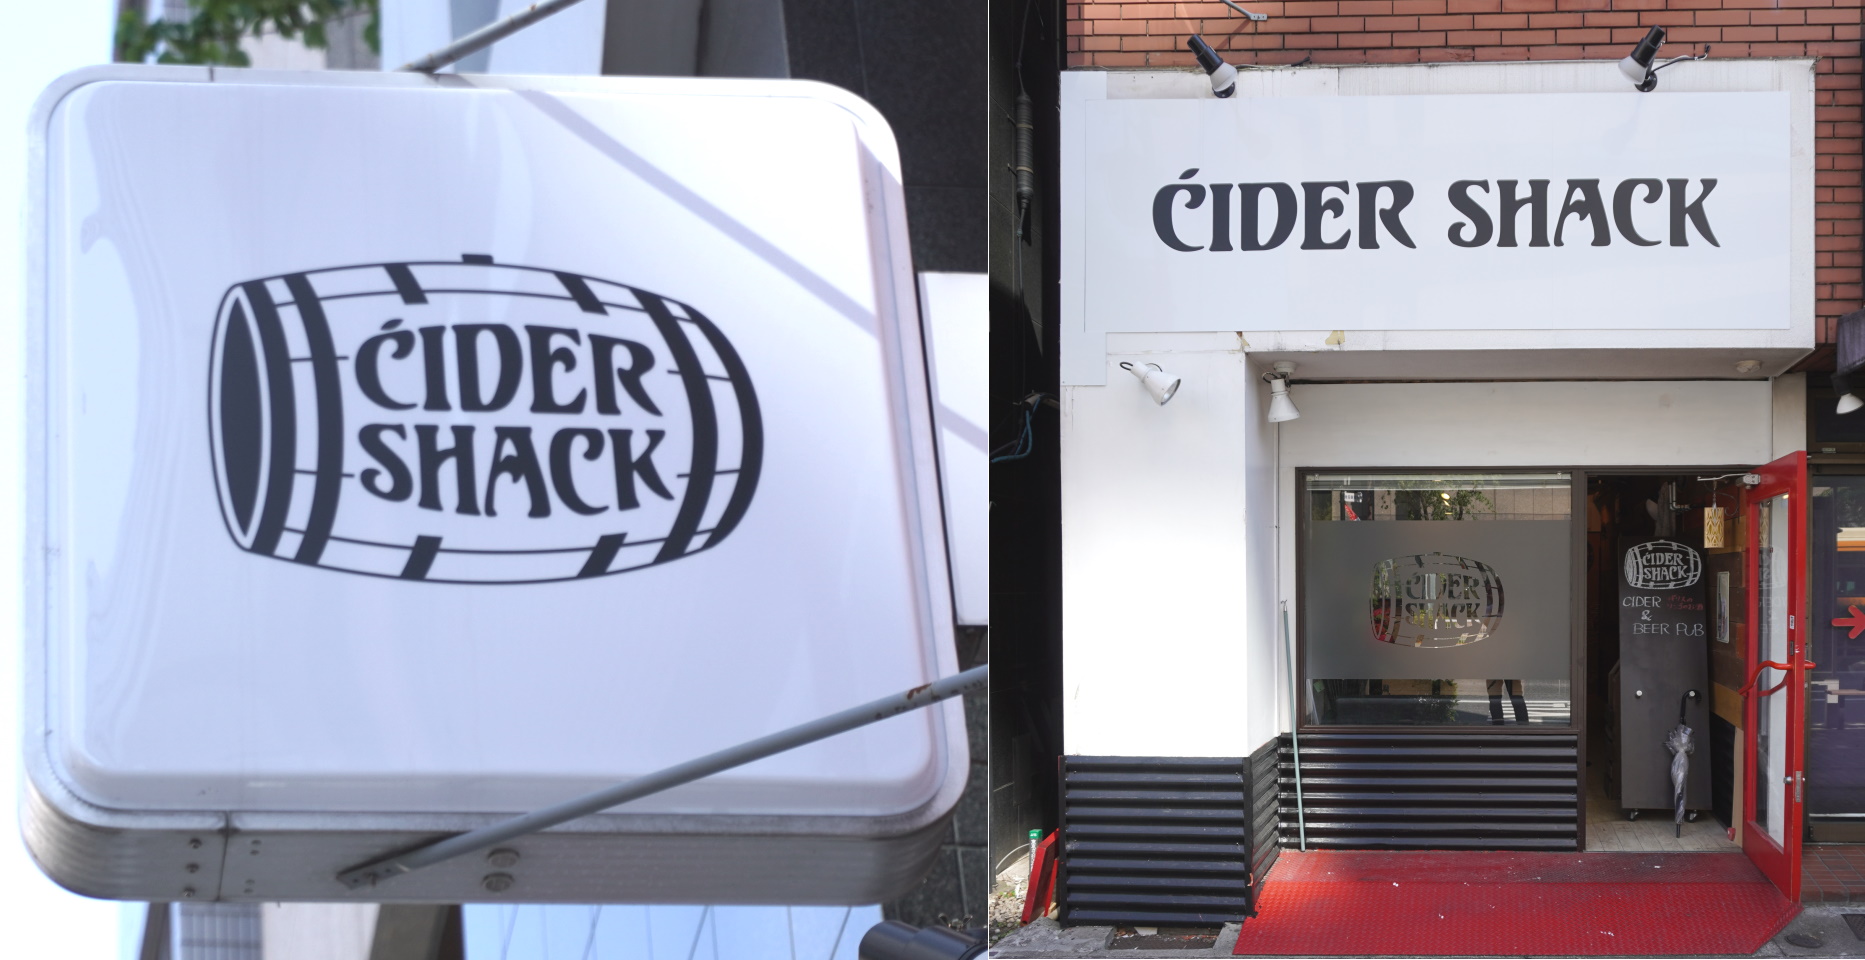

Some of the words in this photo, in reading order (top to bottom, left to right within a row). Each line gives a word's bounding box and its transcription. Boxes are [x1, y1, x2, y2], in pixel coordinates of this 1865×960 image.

[1447, 178, 1721, 248] SHACK
[358, 423, 675, 518] SHACK
[1643, 565, 1687, 580] SHACK
[1622, 595, 1662, 608] CIDER
[1405, 602, 1481, 630] SHACK
[1641, 609, 1653, 621] &
[1633, 622, 1670, 635] BEER
[1676, 622, 1704, 637] PUB
